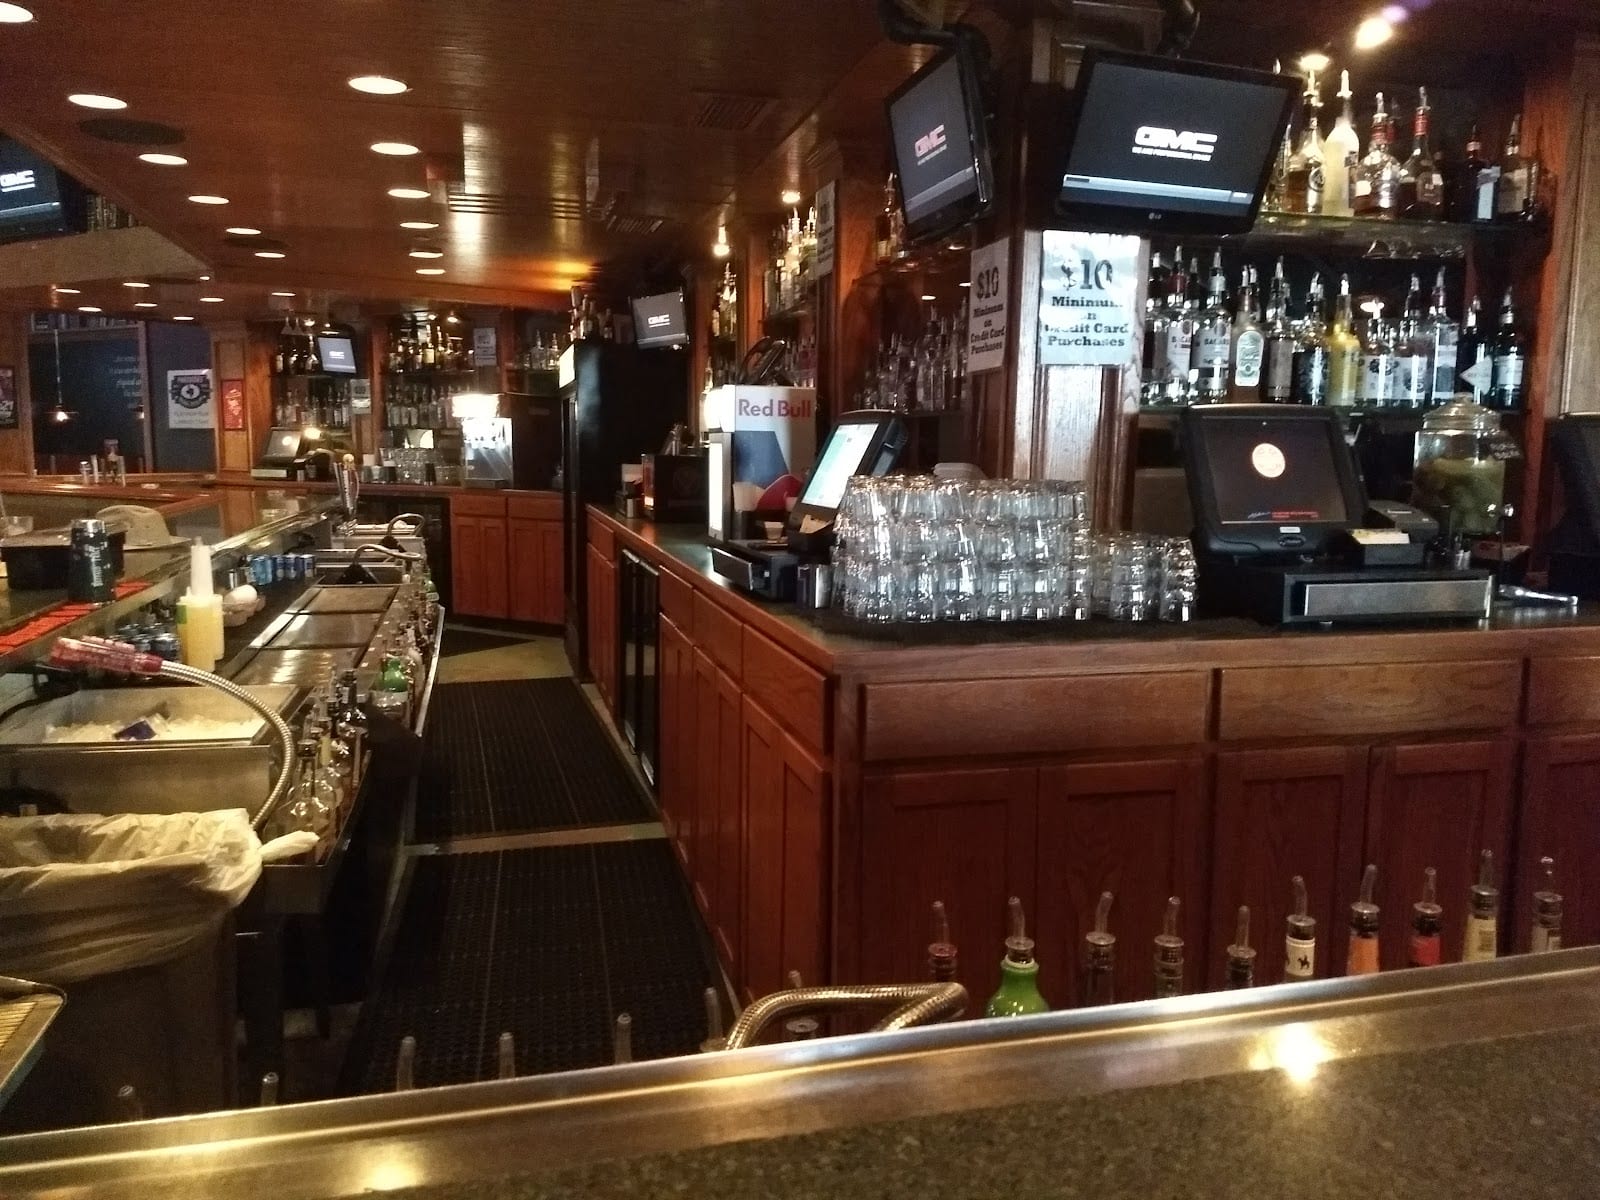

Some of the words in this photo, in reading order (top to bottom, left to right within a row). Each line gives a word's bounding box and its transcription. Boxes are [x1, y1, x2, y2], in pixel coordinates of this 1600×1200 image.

[1134, 126, 1218, 153] GMC
[976, 266, 999, 300] $10
[1060, 259, 1113, 291] $10
[738, 398, 773, 417] Red
[778, 399, 810, 417] Bull
